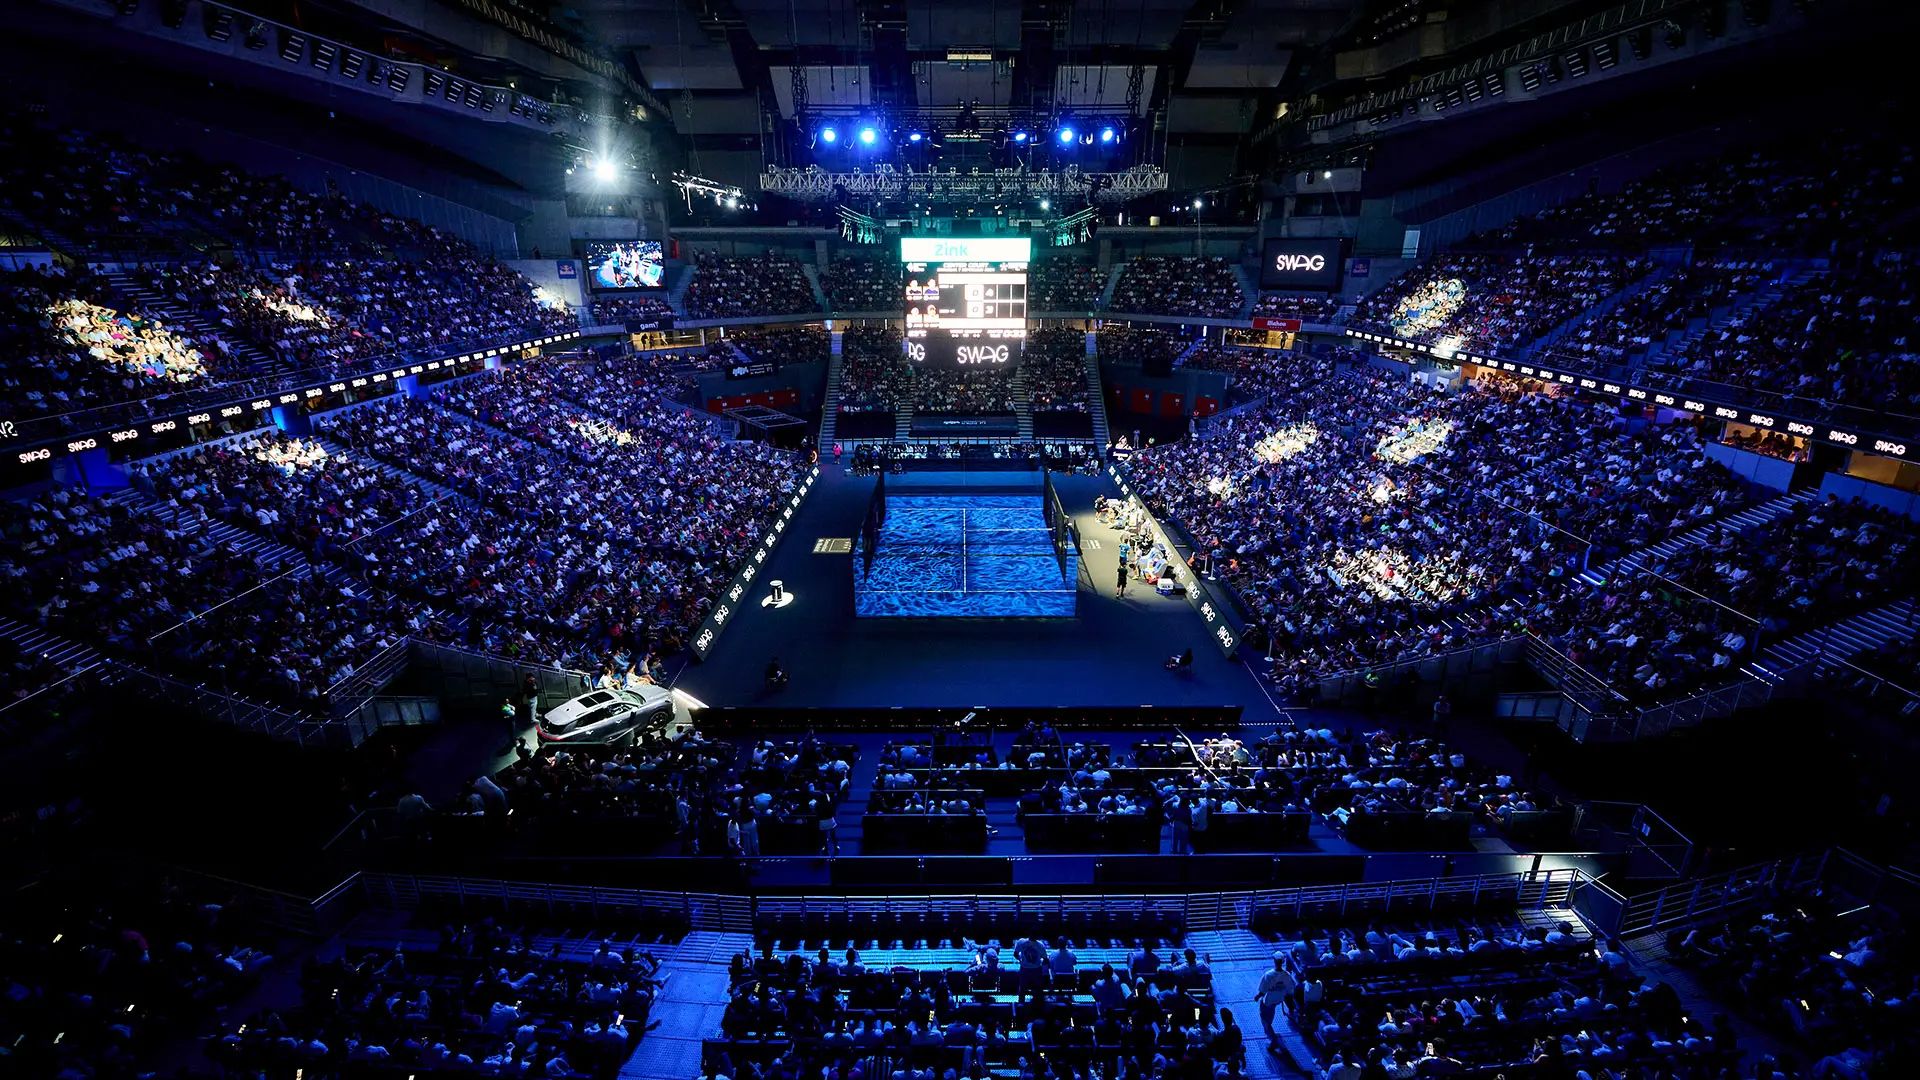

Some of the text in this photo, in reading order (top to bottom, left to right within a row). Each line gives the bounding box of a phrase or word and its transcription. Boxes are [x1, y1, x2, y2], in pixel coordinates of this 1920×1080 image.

[935, 242, 968, 256] Zink
[1276, 254, 1325, 271] SWAG
[957, 344, 1009, 364] SWAG
[18, 448, 51, 464] SWAG
[67, 438, 97, 453] SWAG
[111, 429, 139, 443] SWAG
[151, 420, 176, 434] SWAG
[187, 412, 211, 425] SWAG
[220, 405, 243, 418] SWAG
[251, 399, 272, 411] SWAG
[1655, 394, 1675, 406] SWAG
[1683, 400, 1705, 412] SWAG
[1715, 407, 1738, 419] SWAG
[1749, 414, 1774, 427] SWAG
[1787, 421, 1814, 436] SWAG
[1828, 430, 1858, 445] SWAG
[1874, 440, 1906, 456] SWAG
[696, 628, 713, 652] SWAG
[713, 604, 729, 625] SWAG
[728, 583, 744, 603] SWAG
[1200, 601, 1216, 622] SWAG
[1216, 625, 1234, 648] SWAG
